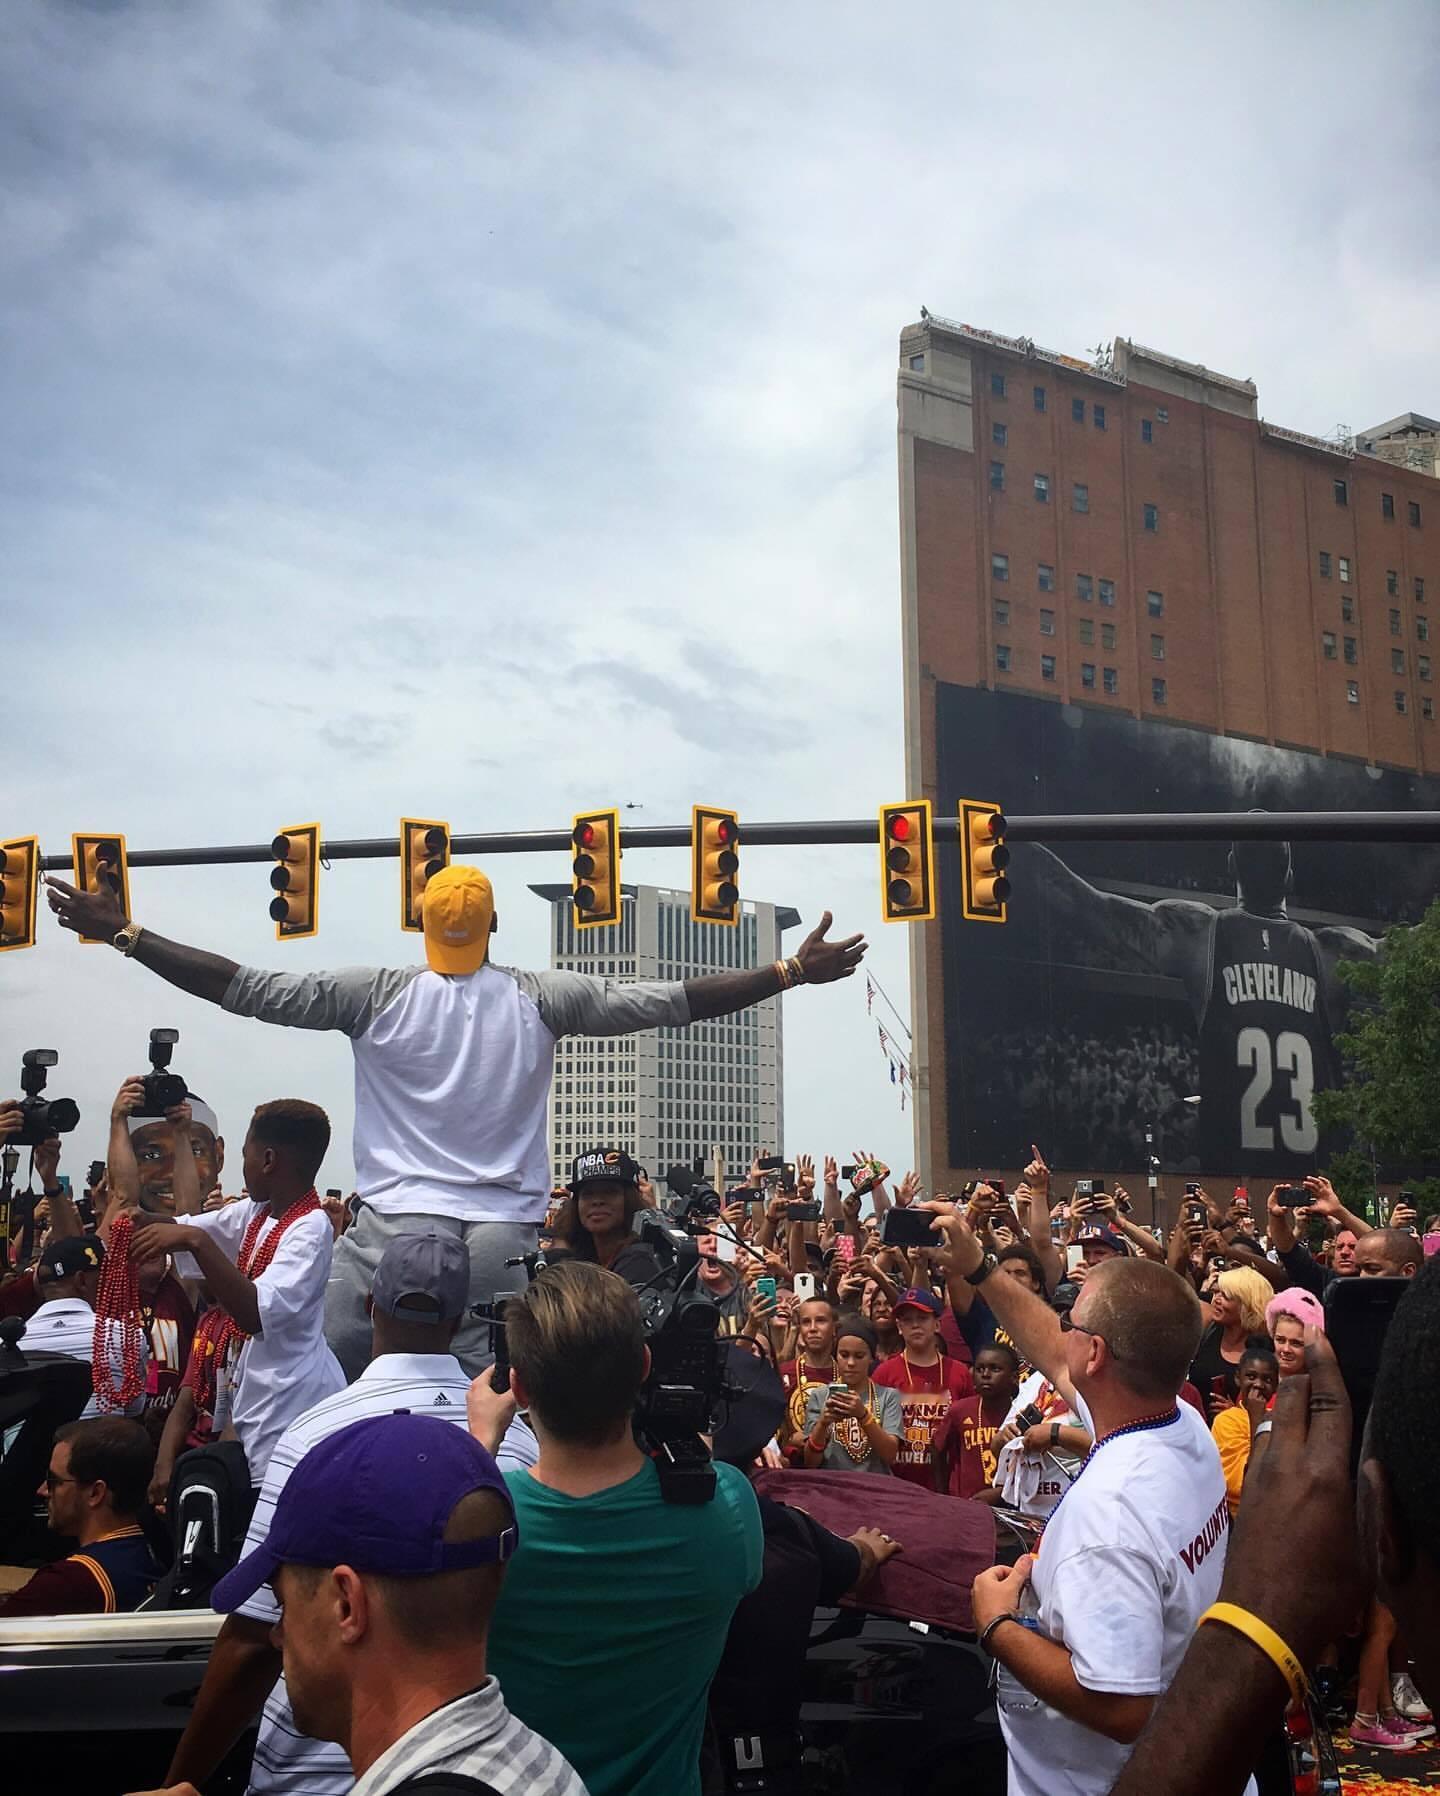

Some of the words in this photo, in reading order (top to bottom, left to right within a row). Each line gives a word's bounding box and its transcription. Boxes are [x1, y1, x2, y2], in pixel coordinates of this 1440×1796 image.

[1223, 963, 1316, 1013] CLEVELAND
[1237, 1027, 1319, 1154] 23
[582, 1153, 605, 1167] NBA
[901, 1402, 949, 1420] WINE
